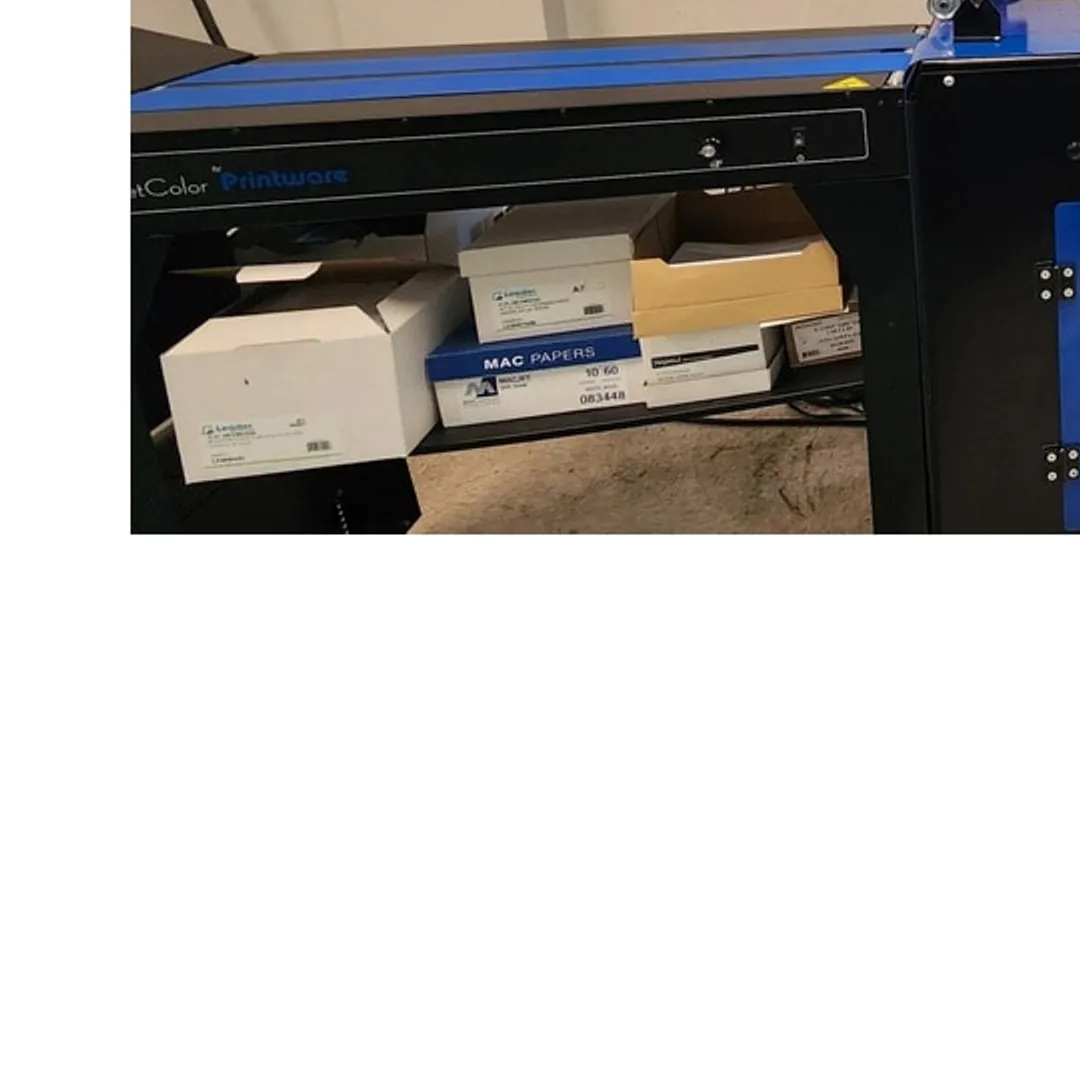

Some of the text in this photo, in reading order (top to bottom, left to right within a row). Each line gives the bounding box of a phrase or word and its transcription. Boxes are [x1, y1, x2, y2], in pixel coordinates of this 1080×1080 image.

[219, 169, 348, 191] Printware
[483, 346, 596, 370] MAC PAPERS
[579, 390, 625, 405] 083448
